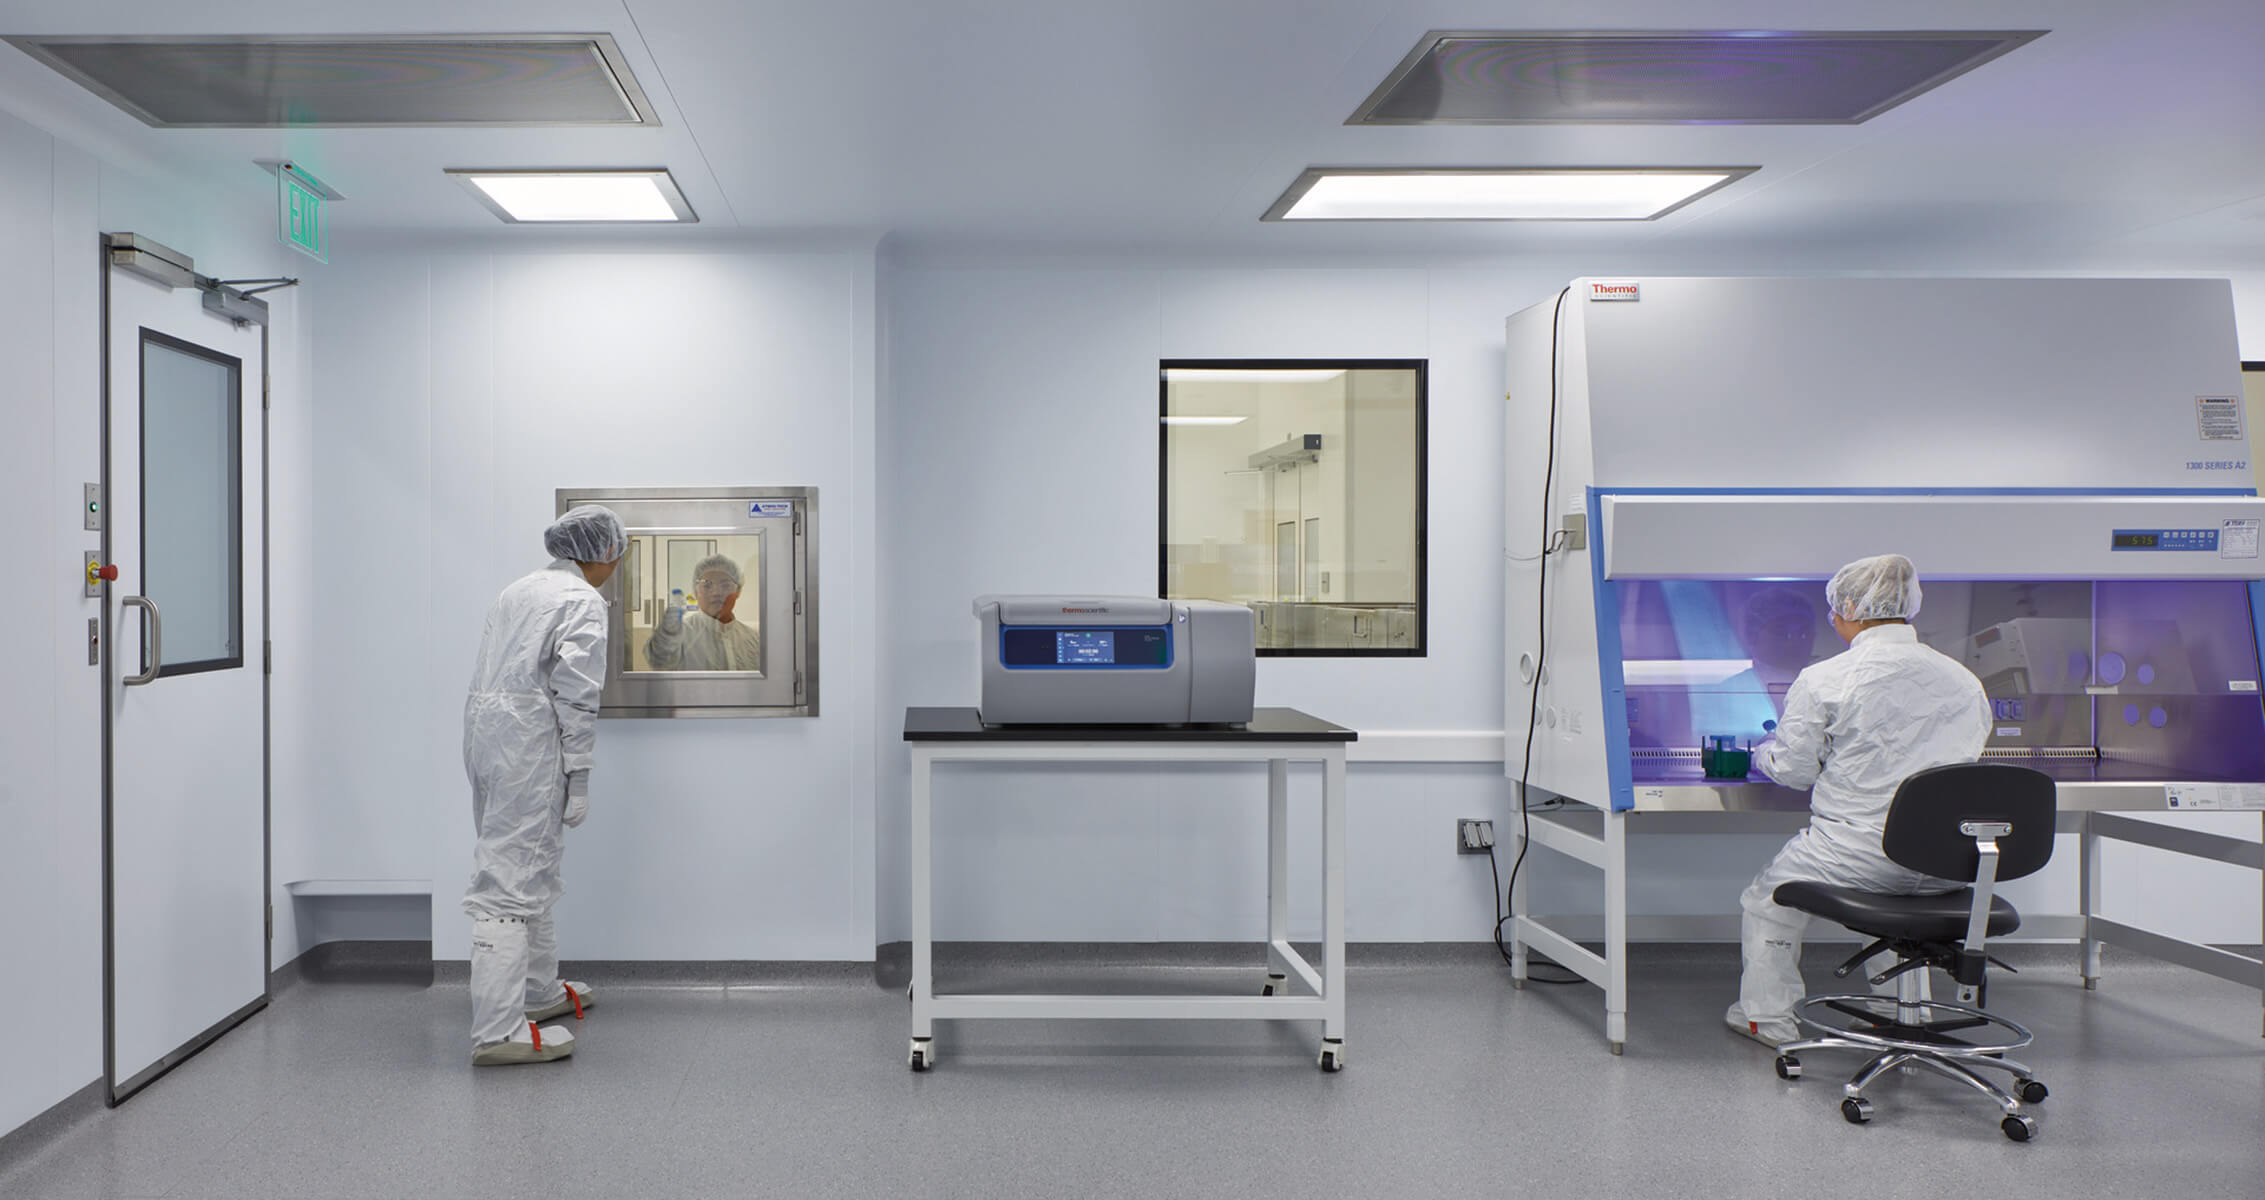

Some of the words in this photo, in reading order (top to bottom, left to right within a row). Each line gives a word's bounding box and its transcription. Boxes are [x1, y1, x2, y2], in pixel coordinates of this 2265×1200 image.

[289, 180, 320, 254] EXIT
[1592, 284, 1637, 293] Thermo
[2185, 461, 2203, 470] 1300
[2204, 460, 2234, 470] SERIES
[2234, 460, 2247, 470] A2
